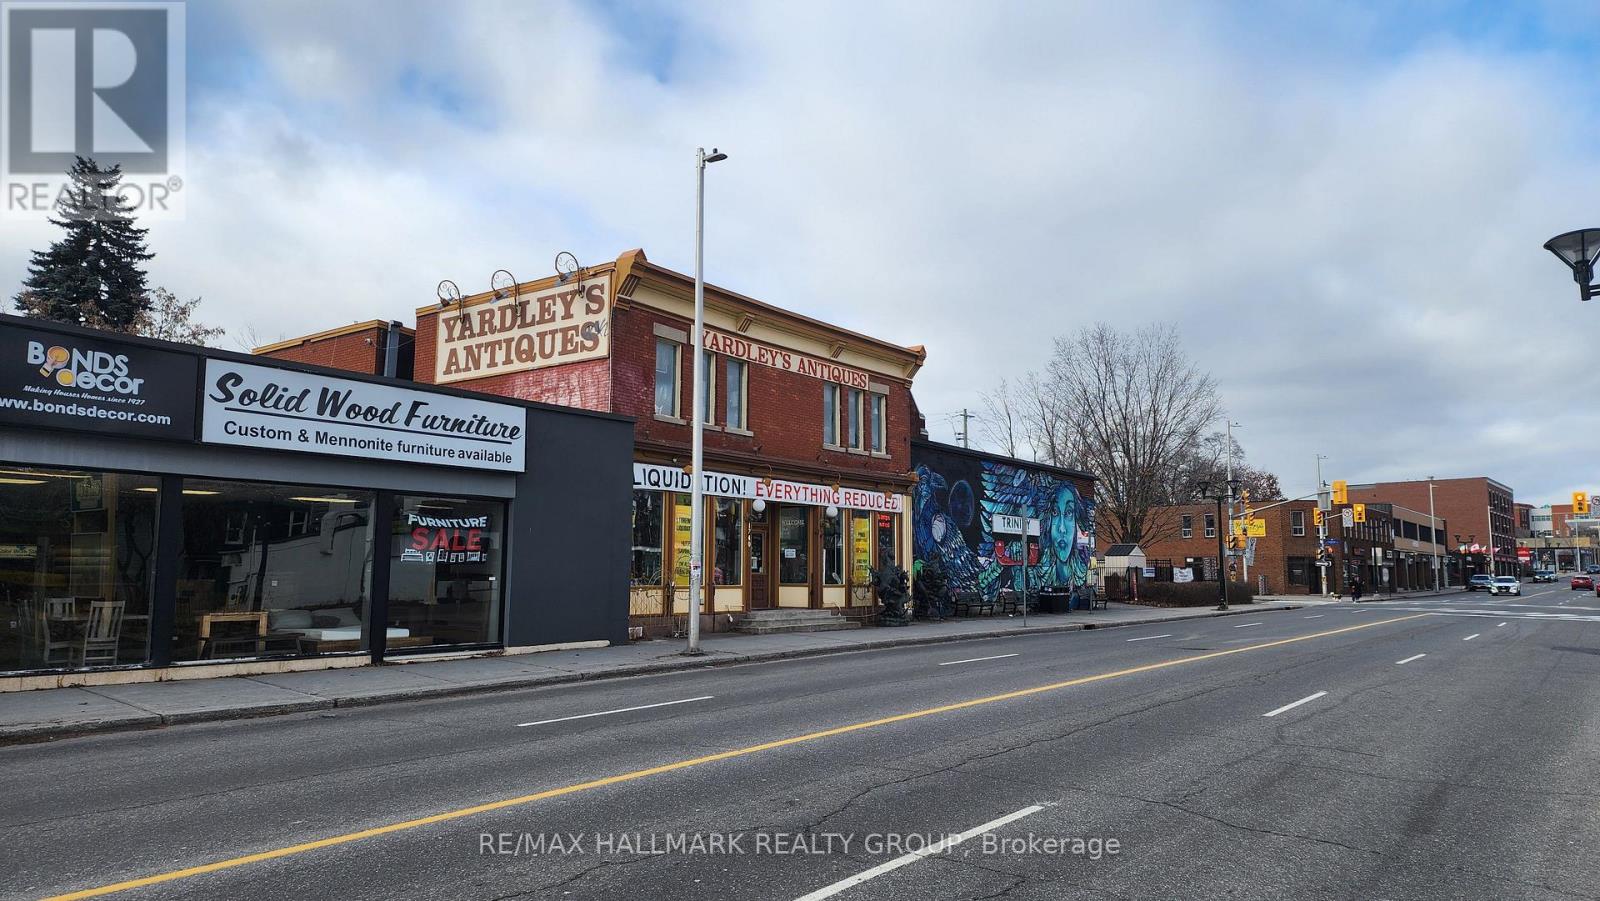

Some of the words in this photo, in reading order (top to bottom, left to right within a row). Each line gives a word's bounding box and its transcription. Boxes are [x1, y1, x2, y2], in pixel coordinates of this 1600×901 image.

[442, 283, 605, 343] YARDLEY'S
[27, 341, 129, 377] BONDS
[443, 320, 600, 375] ANTIQUES
[703, 330, 792, 370] YARDLEY'S
[798, 357, 867, 389] ANTIQUES
[23, 385, 53, 396] Making
[53, 389, 80, 398] Houses
[81, 392, 105, 401] Homes
[127, 398, 146, 406] 1927
[209, 371, 311, 413] Solid
[317, 386, 402, 425] Wood
[404, 400, 523, 440] Furniture
[224, 420, 292, 441] Custom
[298, 428, 310, 443] &
[315, 431, 393, 452] Mennonite
[397, 439, 455, 459] furniture
[458, 449, 513, 464] available
[632, 467, 747, 496] LIQUIDTION!
[755, 480, 841, 505] EVERYTHING
[844, 491, 899, 510] REDUCED
[407, 513, 488, 528] FURNITURE
[411, 527, 482, 551] SALE
[1002, 516, 1031, 530] TRINIY
